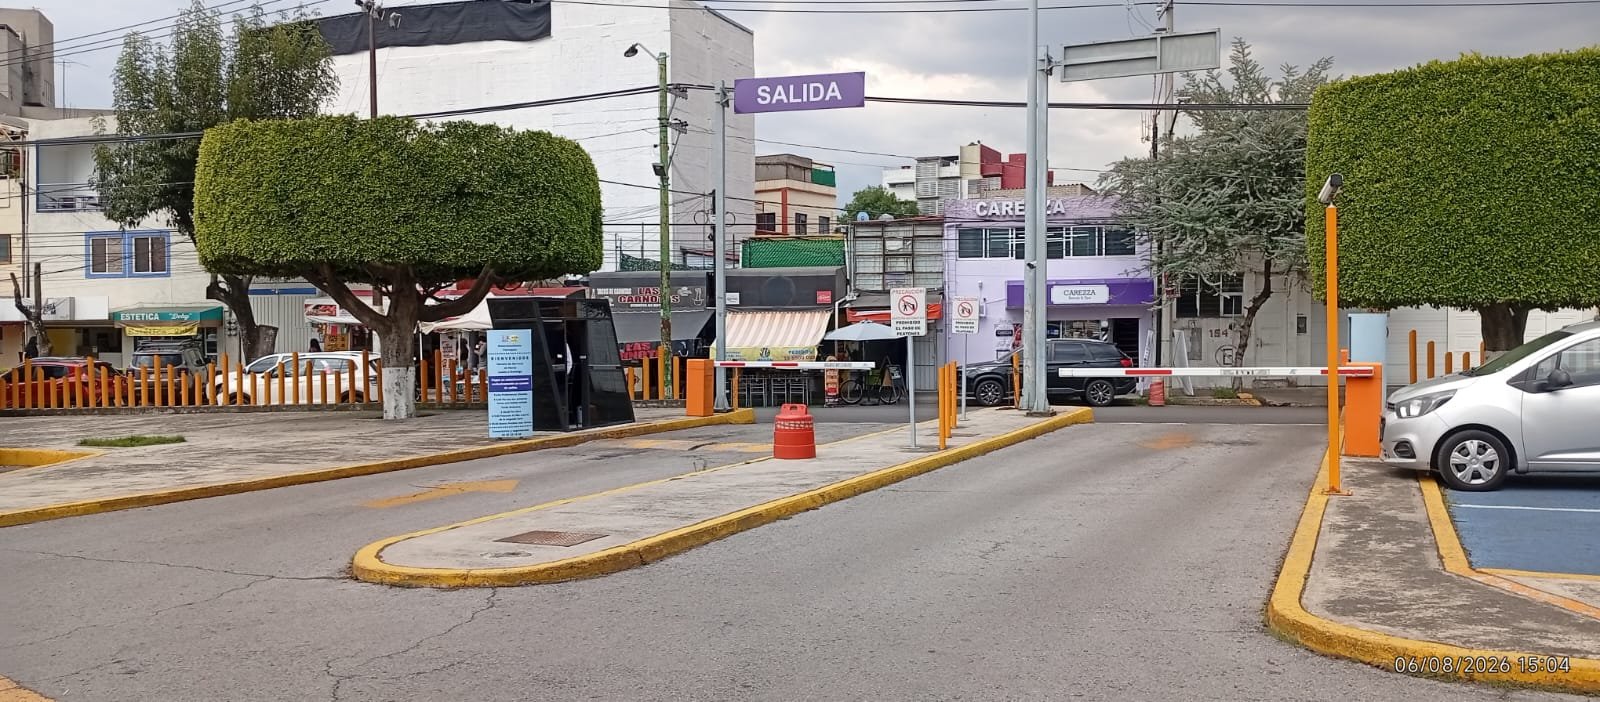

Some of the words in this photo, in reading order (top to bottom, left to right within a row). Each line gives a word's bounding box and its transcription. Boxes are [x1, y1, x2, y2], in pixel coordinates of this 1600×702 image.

[756, 81, 842, 105] SALIDA
[975, 199, 1066, 217] CAREA
[638, 287, 660, 295] LAS
[618, 295, 681, 304] CARNOS
[120, 312, 160, 321] ESTETICA
